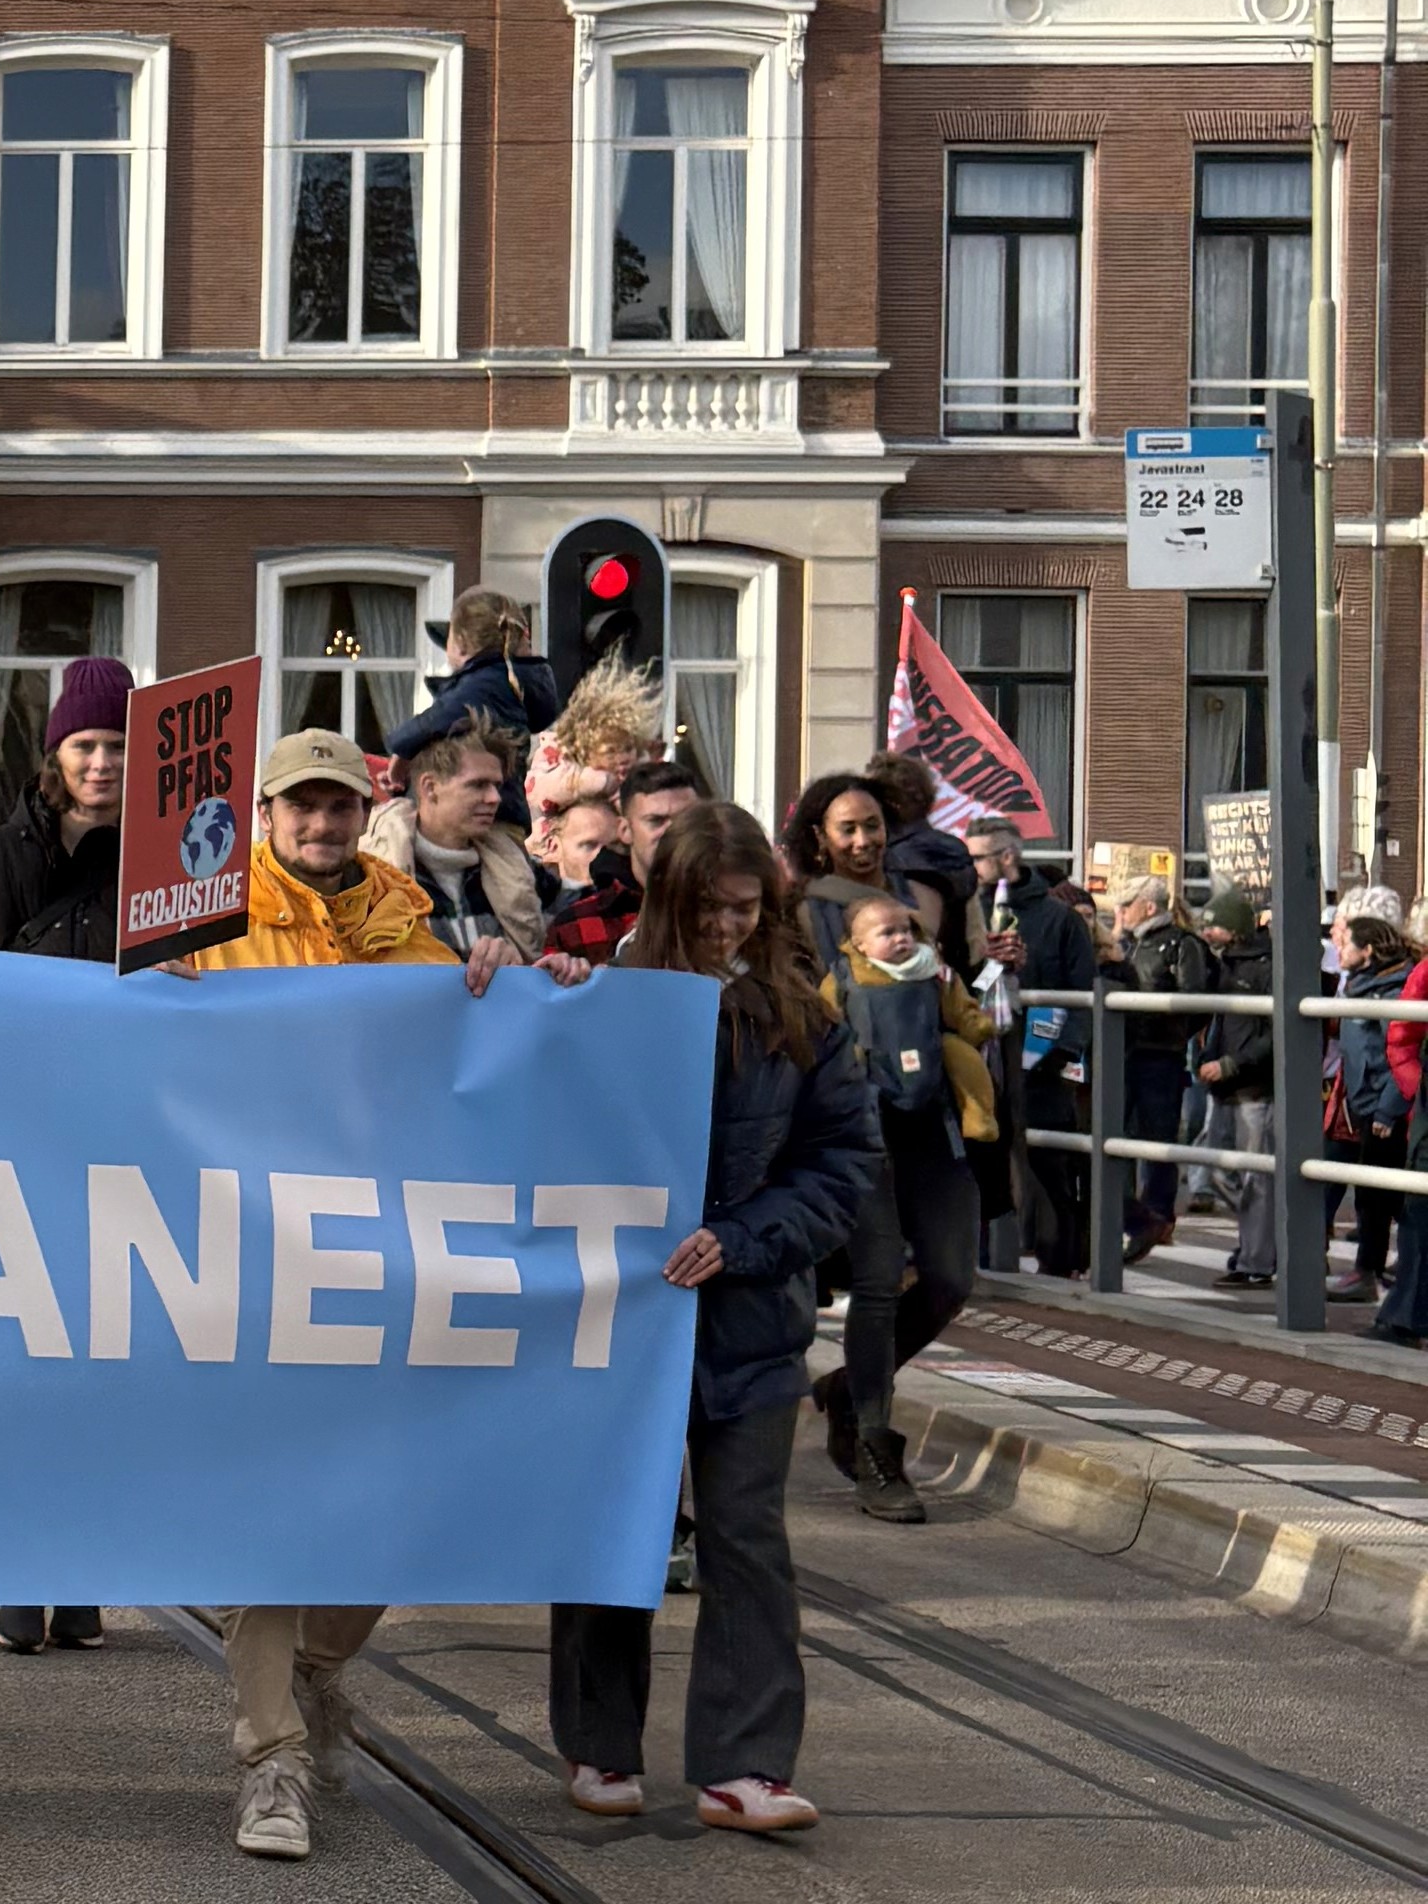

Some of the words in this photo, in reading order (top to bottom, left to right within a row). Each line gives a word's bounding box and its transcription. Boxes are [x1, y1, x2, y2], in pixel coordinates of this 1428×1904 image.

[1139, 464, 1205, 475] Javastraat
[1140, 490, 1168, 508] 22
[1177, 488, 1205, 508] 24
[1215, 489, 1243, 507] 28
[157, 685, 233, 761] STOP
[158, 742, 233, 817] PFAS
[1211, 838, 1257, 856] LINKS
[128, 871, 243, 932] ECOJUSTICE
